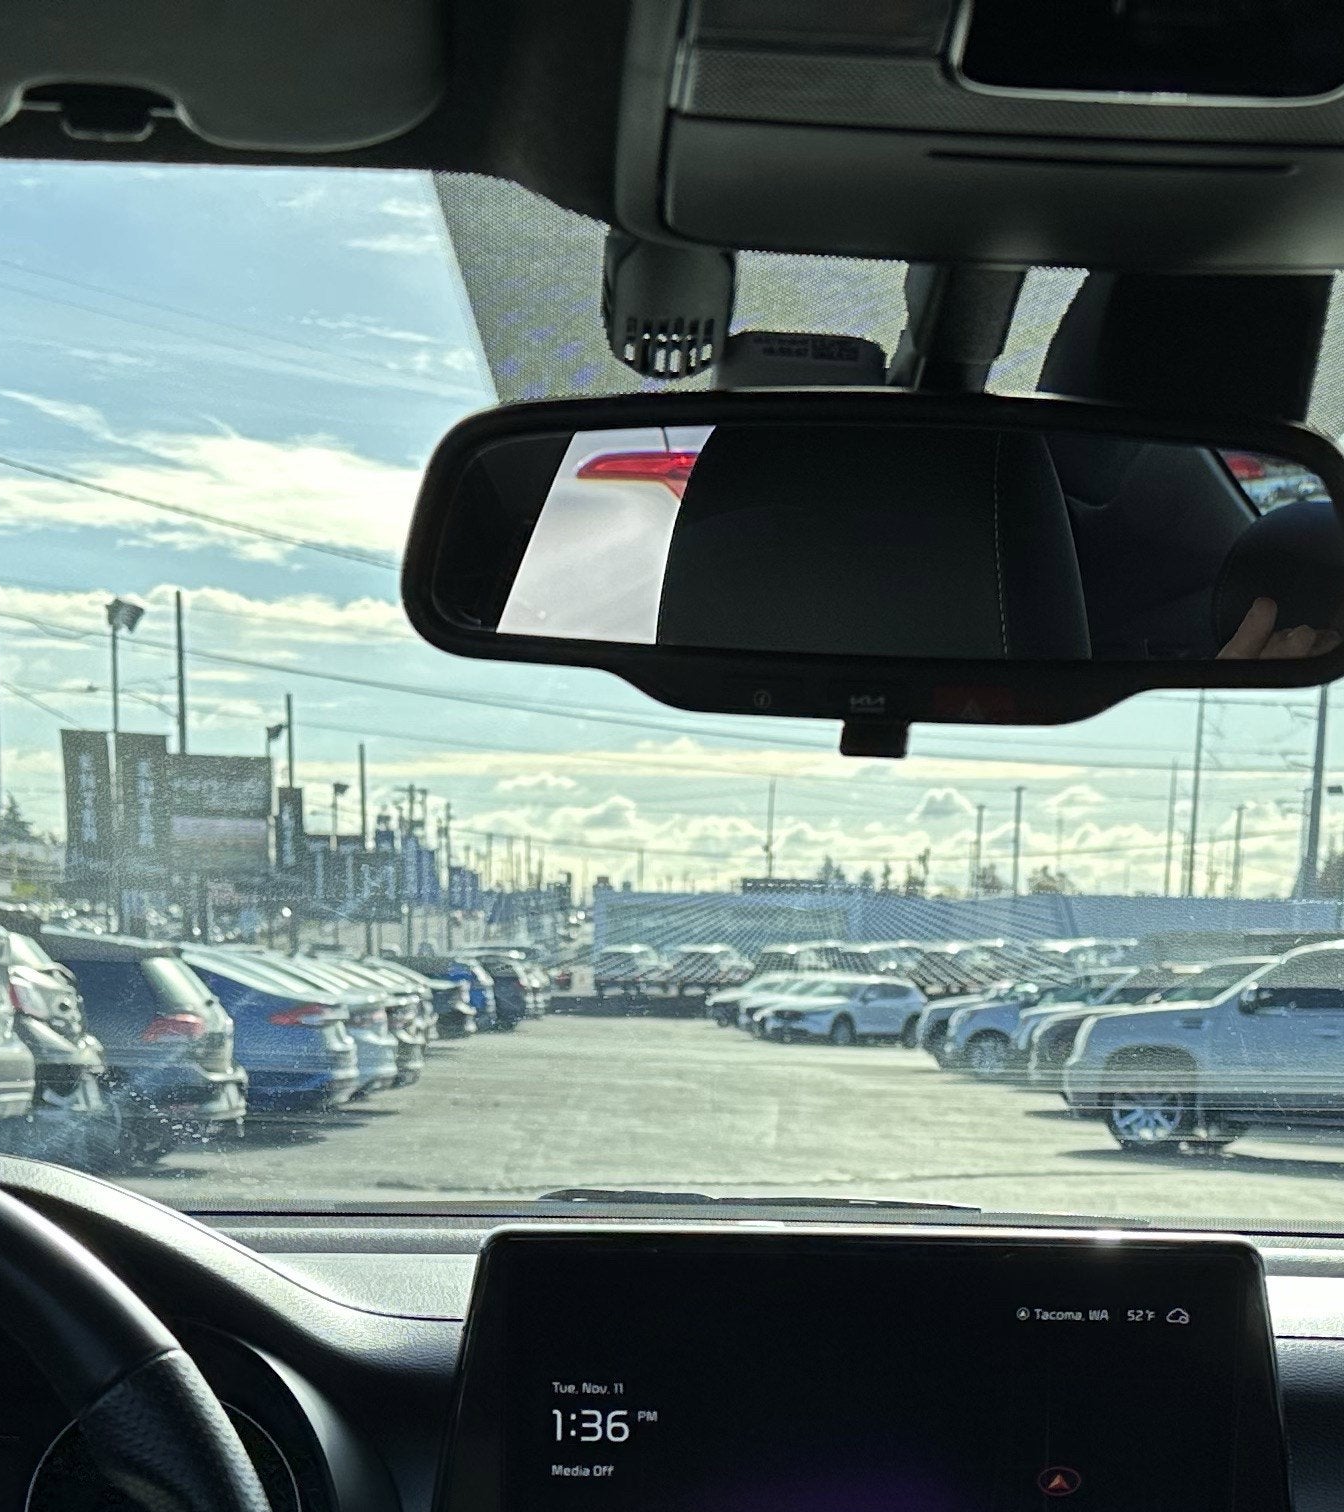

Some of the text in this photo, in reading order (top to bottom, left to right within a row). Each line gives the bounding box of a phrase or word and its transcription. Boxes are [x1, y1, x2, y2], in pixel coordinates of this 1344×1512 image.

[1089, 1309, 1109, 1321] WA
[613, 1382, 624, 1394] 11
[552, 1408, 658, 1442] 1:36 PM
[551, 1465, 615, 1477] Media Off
